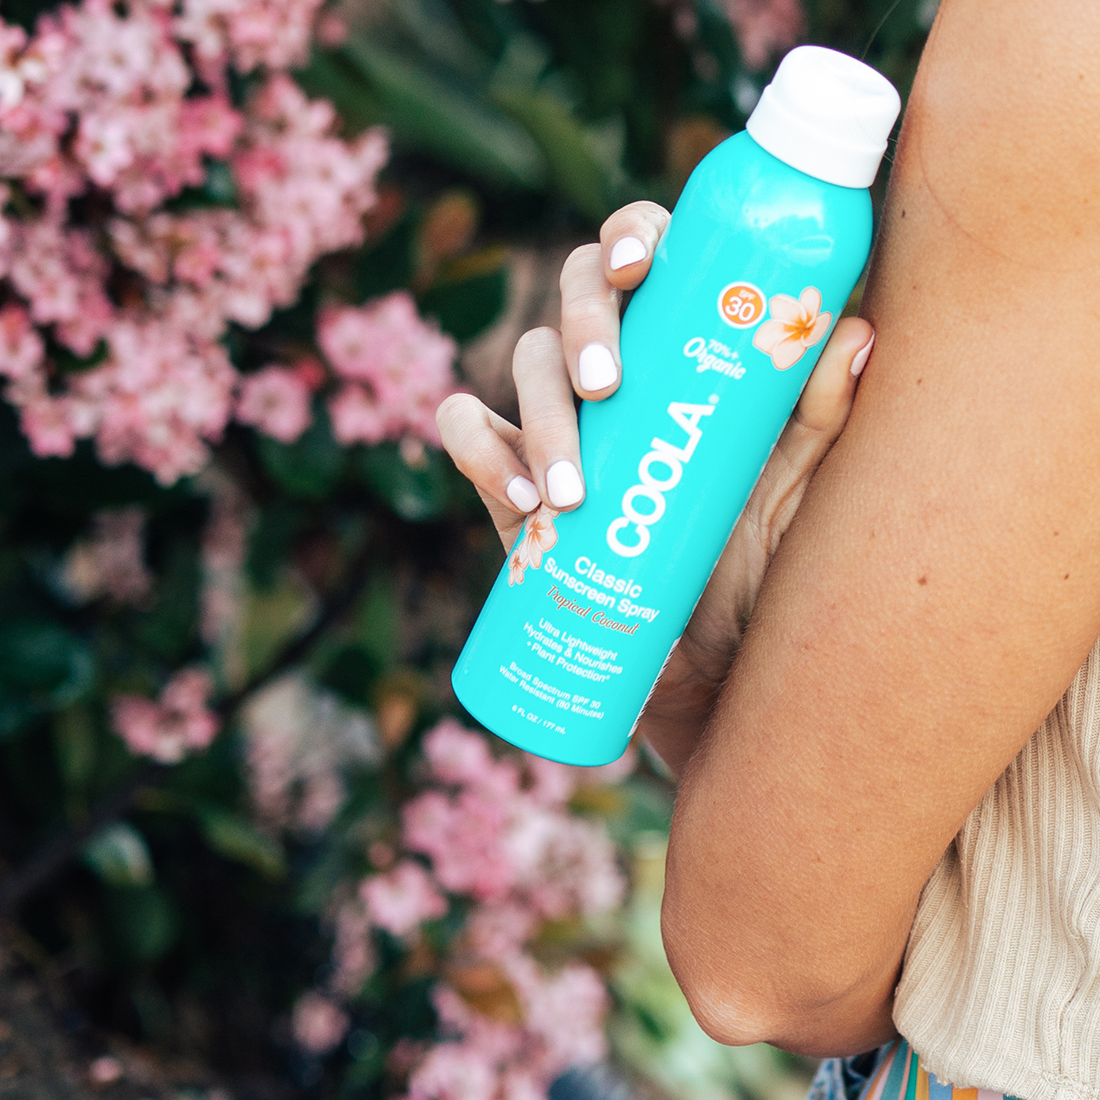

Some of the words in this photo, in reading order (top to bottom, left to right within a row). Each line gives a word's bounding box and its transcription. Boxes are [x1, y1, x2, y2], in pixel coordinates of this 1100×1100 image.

[725, 296, 755, 322] 30
[738, 289, 756, 301] SPF
[683, 336, 747, 380] Organic
[606, 401, 716, 558] COOLA
[544, 557, 616, 609] Sunscreen
[617, 598, 660, 623] Spray
[574, 556, 643, 599] Classic
[547, 584, 592, 618] Tropical
[591, 611, 640, 635] Coconut
[523, 621, 564, 653] Hydrates
[563, 646, 573, 659] &
[573, 651, 624, 675] Nourishes
[531, 641, 556, 663] Plant
[538, 617, 561, 638] Ultra
[561, 630, 618, 661] Lightweight
[499, 664, 519, 684] Water
[518, 679, 556, 705] Resistant
[570, 704, 605, 721] Minutes)
[509, 661, 533, 681] Broad
[532, 676, 562, 701] Spectrum
[571, 694, 591, 706] SPF
[589, 700, 602, 710] 30
[517, 707, 526, 718] FL
[526, 712, 539, 724] OZ
[542, 719, 556, 730] 177
